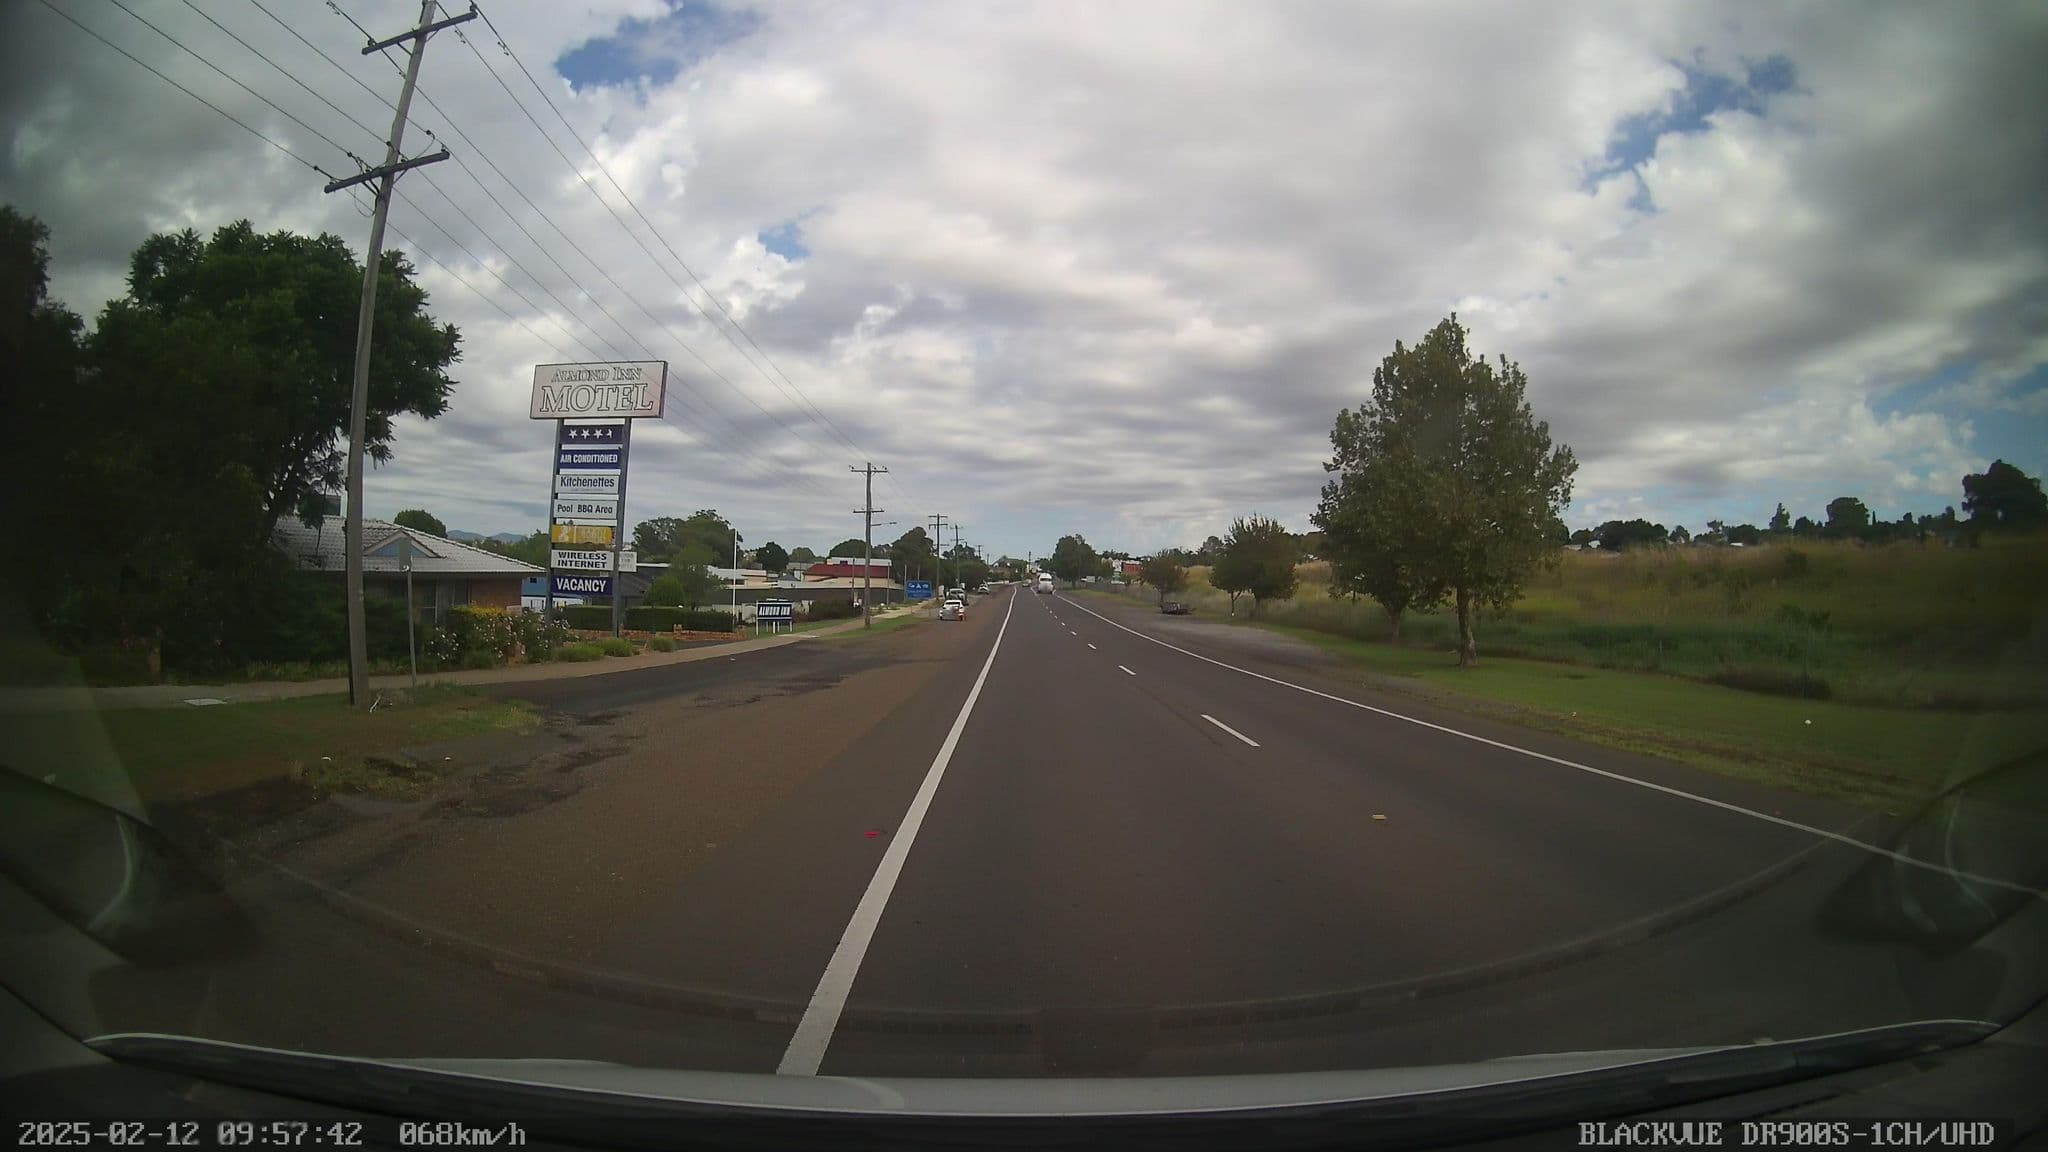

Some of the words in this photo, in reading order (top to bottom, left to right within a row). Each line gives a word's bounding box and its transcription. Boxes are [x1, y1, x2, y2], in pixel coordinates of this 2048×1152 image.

[551, 369, 609, 382] ALMOND
[612, 366, 642, 380] INN
[540, 383, 654, 412] MOTEL
[560, 454, 572, 463] AIR
[573, 454, 618, 463] CONDITIONED
[560, 476, 615, 487] Kitchenettes
[557, 504, 573, 513] Pool
[577, 504, 593, 513] BBQ
[594, 505, 612, 514] Area
[558, 551, 607, 560] WIRELESS
[557, 560, 607, 569] INTERNET
[556, 577, 606, 592] VACANCY
